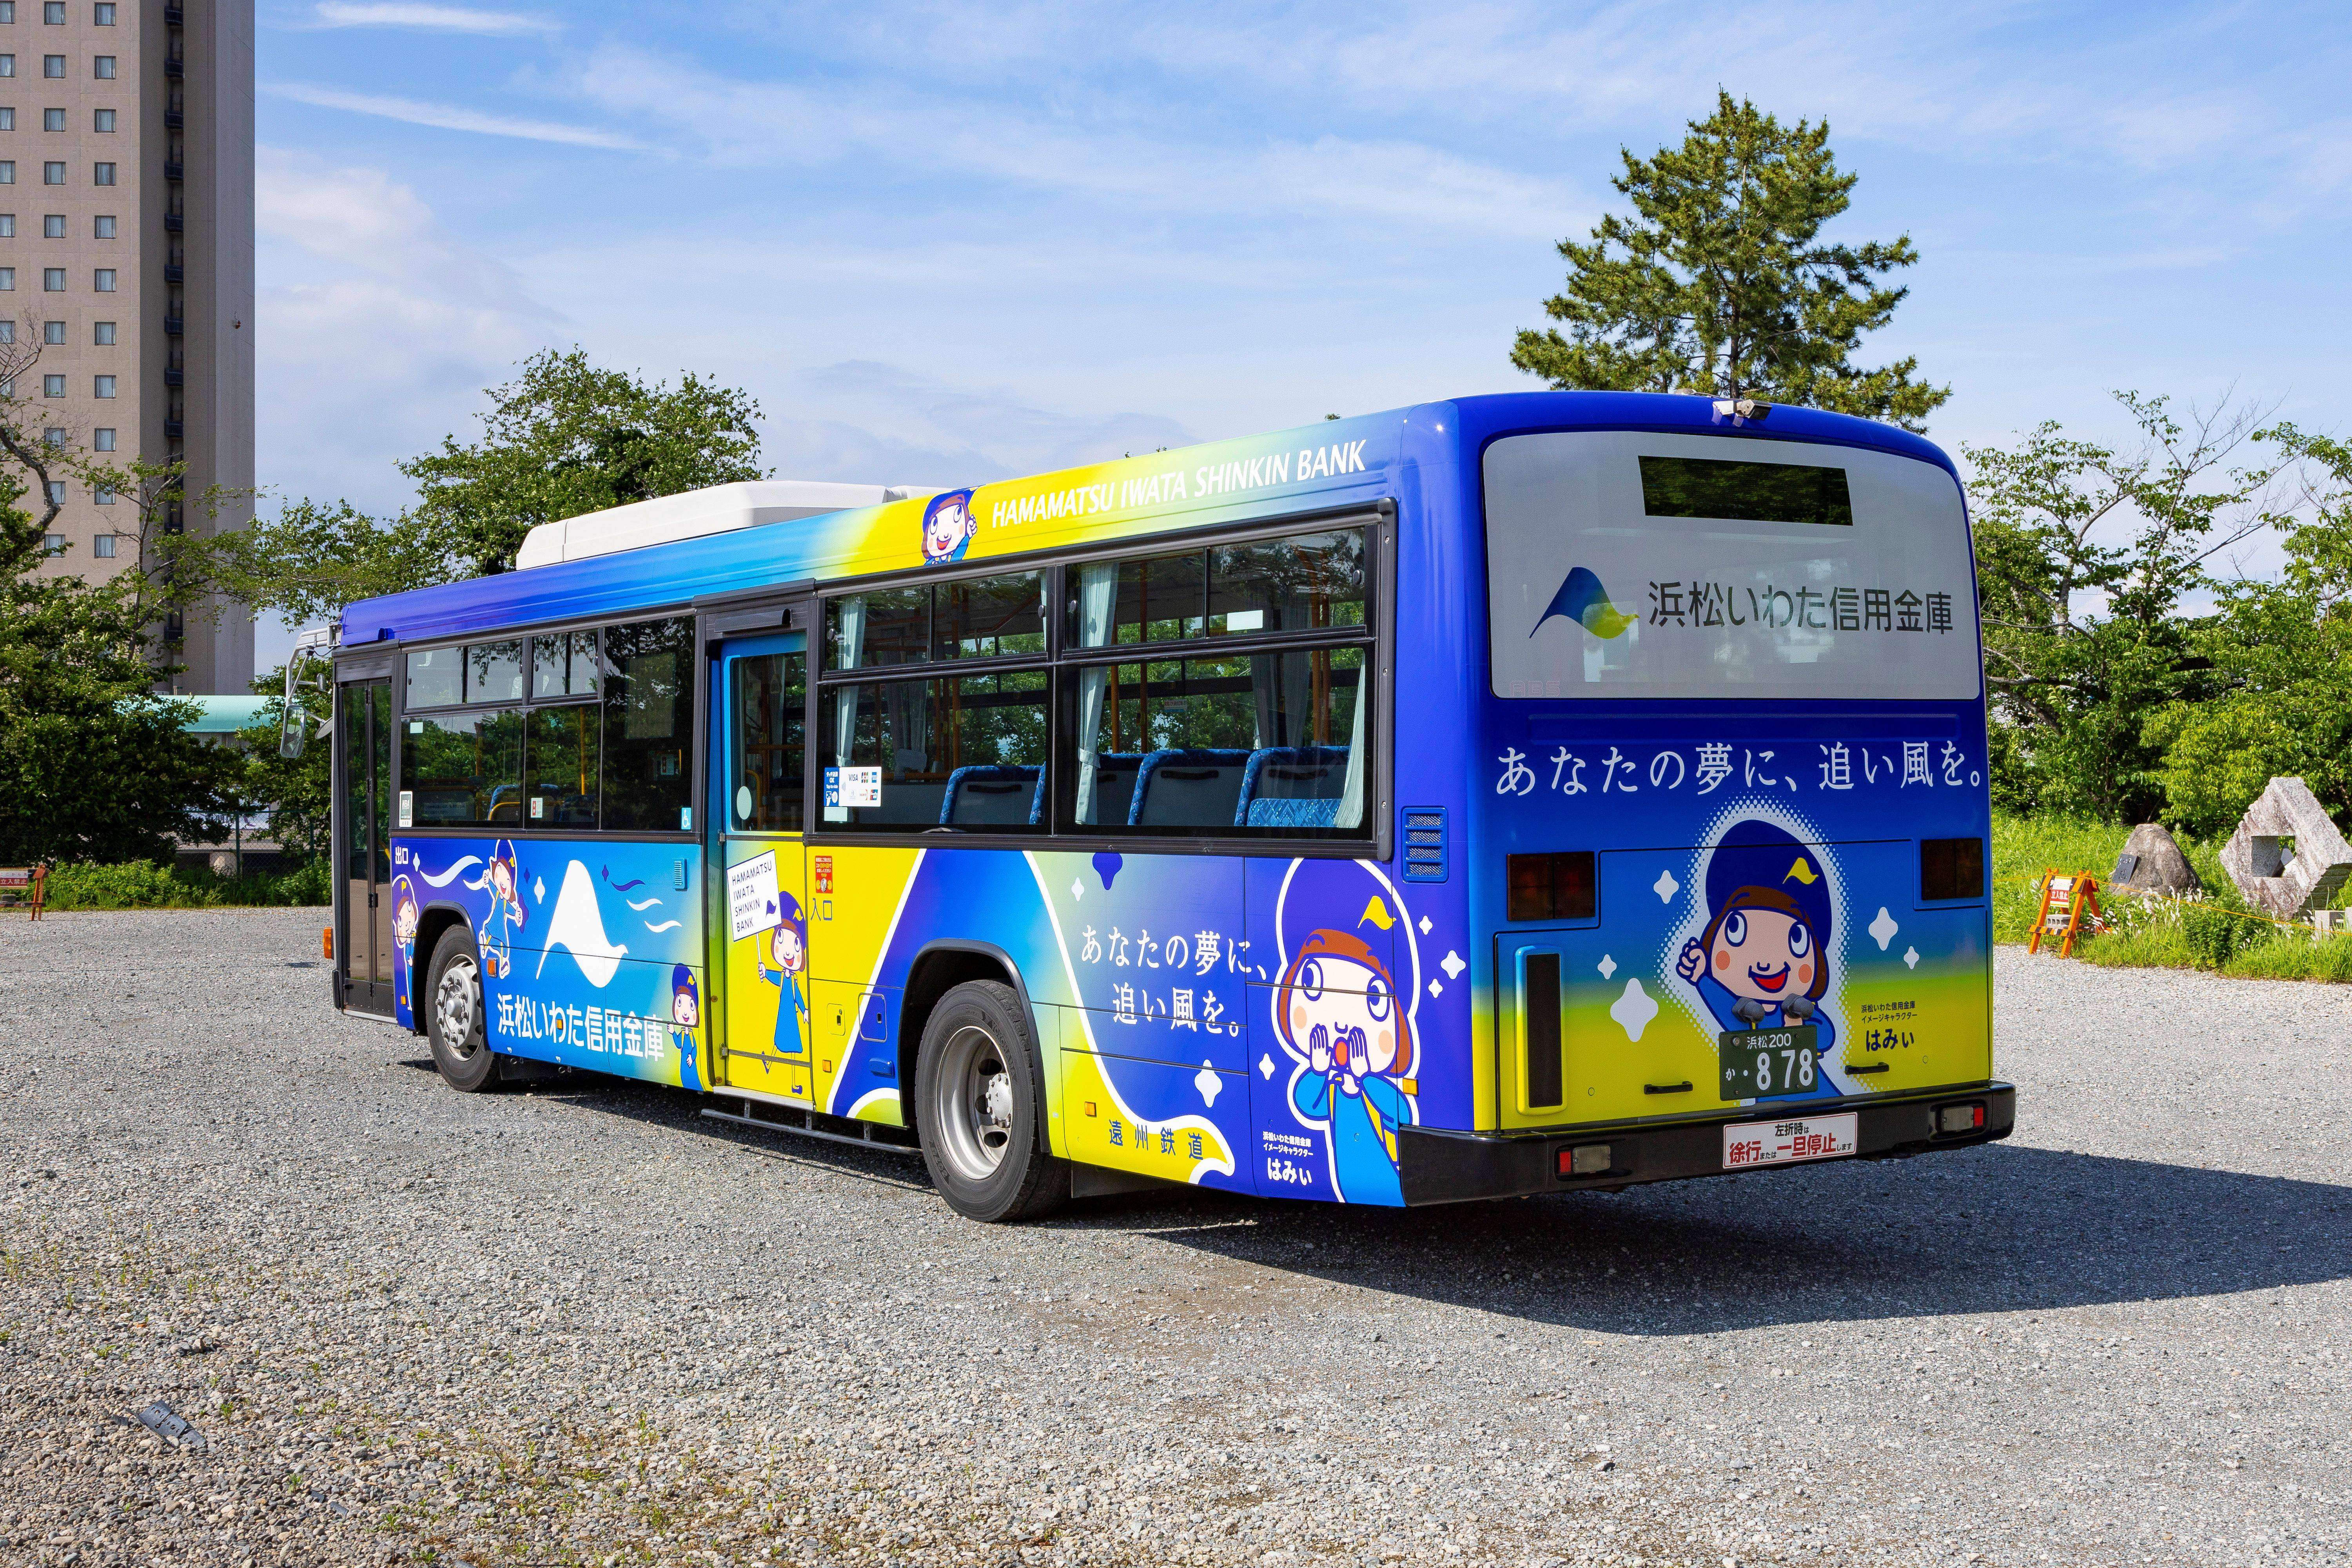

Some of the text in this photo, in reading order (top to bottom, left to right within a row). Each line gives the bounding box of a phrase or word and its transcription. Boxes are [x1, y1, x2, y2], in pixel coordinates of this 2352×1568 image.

[993, 439, 1367, 528] HAMAMATSU IWATA SHINKIN BANK
[1648, 581, 1953, 635] 浜松いわた信用金庫
[1510, 681, 1560, 697] ABS
[395, 846, 408, 864] 出口
[732, 860, 772, 886] HAMAMATSU
[733, 884, 755, 901] IWATA
[735, 898, 760, 916] SHINKIN
[810, 897, 833, 922] 入口
[737, 917, 753, 932] BANK
[1861, 1012, 1918, 1024] イメージキャラクター
[497, 993, 665, 1062] 浜松いわた信用金庫
[1775, 1122, 1809, 1137] 左折時は
[1109, 1119, 1204, 1160] 遠州鉄道
[1263, 1142, 1314, 1157] イメージキャラクター
